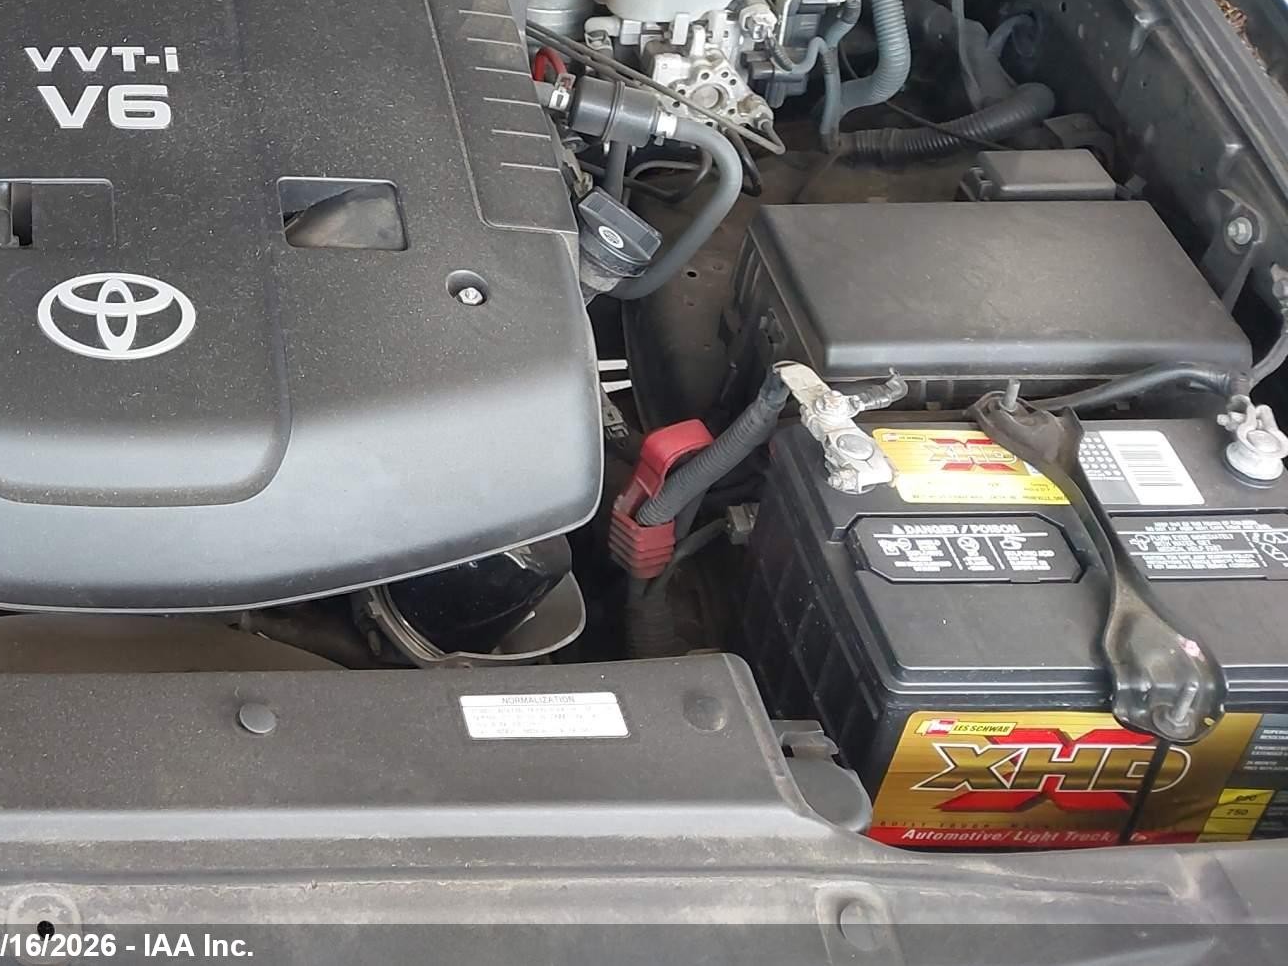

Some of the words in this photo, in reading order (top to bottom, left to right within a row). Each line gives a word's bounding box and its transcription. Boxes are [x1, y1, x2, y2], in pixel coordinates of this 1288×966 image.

[24, 46, 179, 72] VVT-i
[37, 84, 172, 129] V6
[902, 524, 960, 534] DANGER
[969, 524, 1022, 534] POISON
[501, 695, 575, 705] NORMALIZATION
[971, 725, 1011, 733] SCHWAB
[910, 742, 1192, 794] XHD
[1013, 829, 1059, 843] Light
